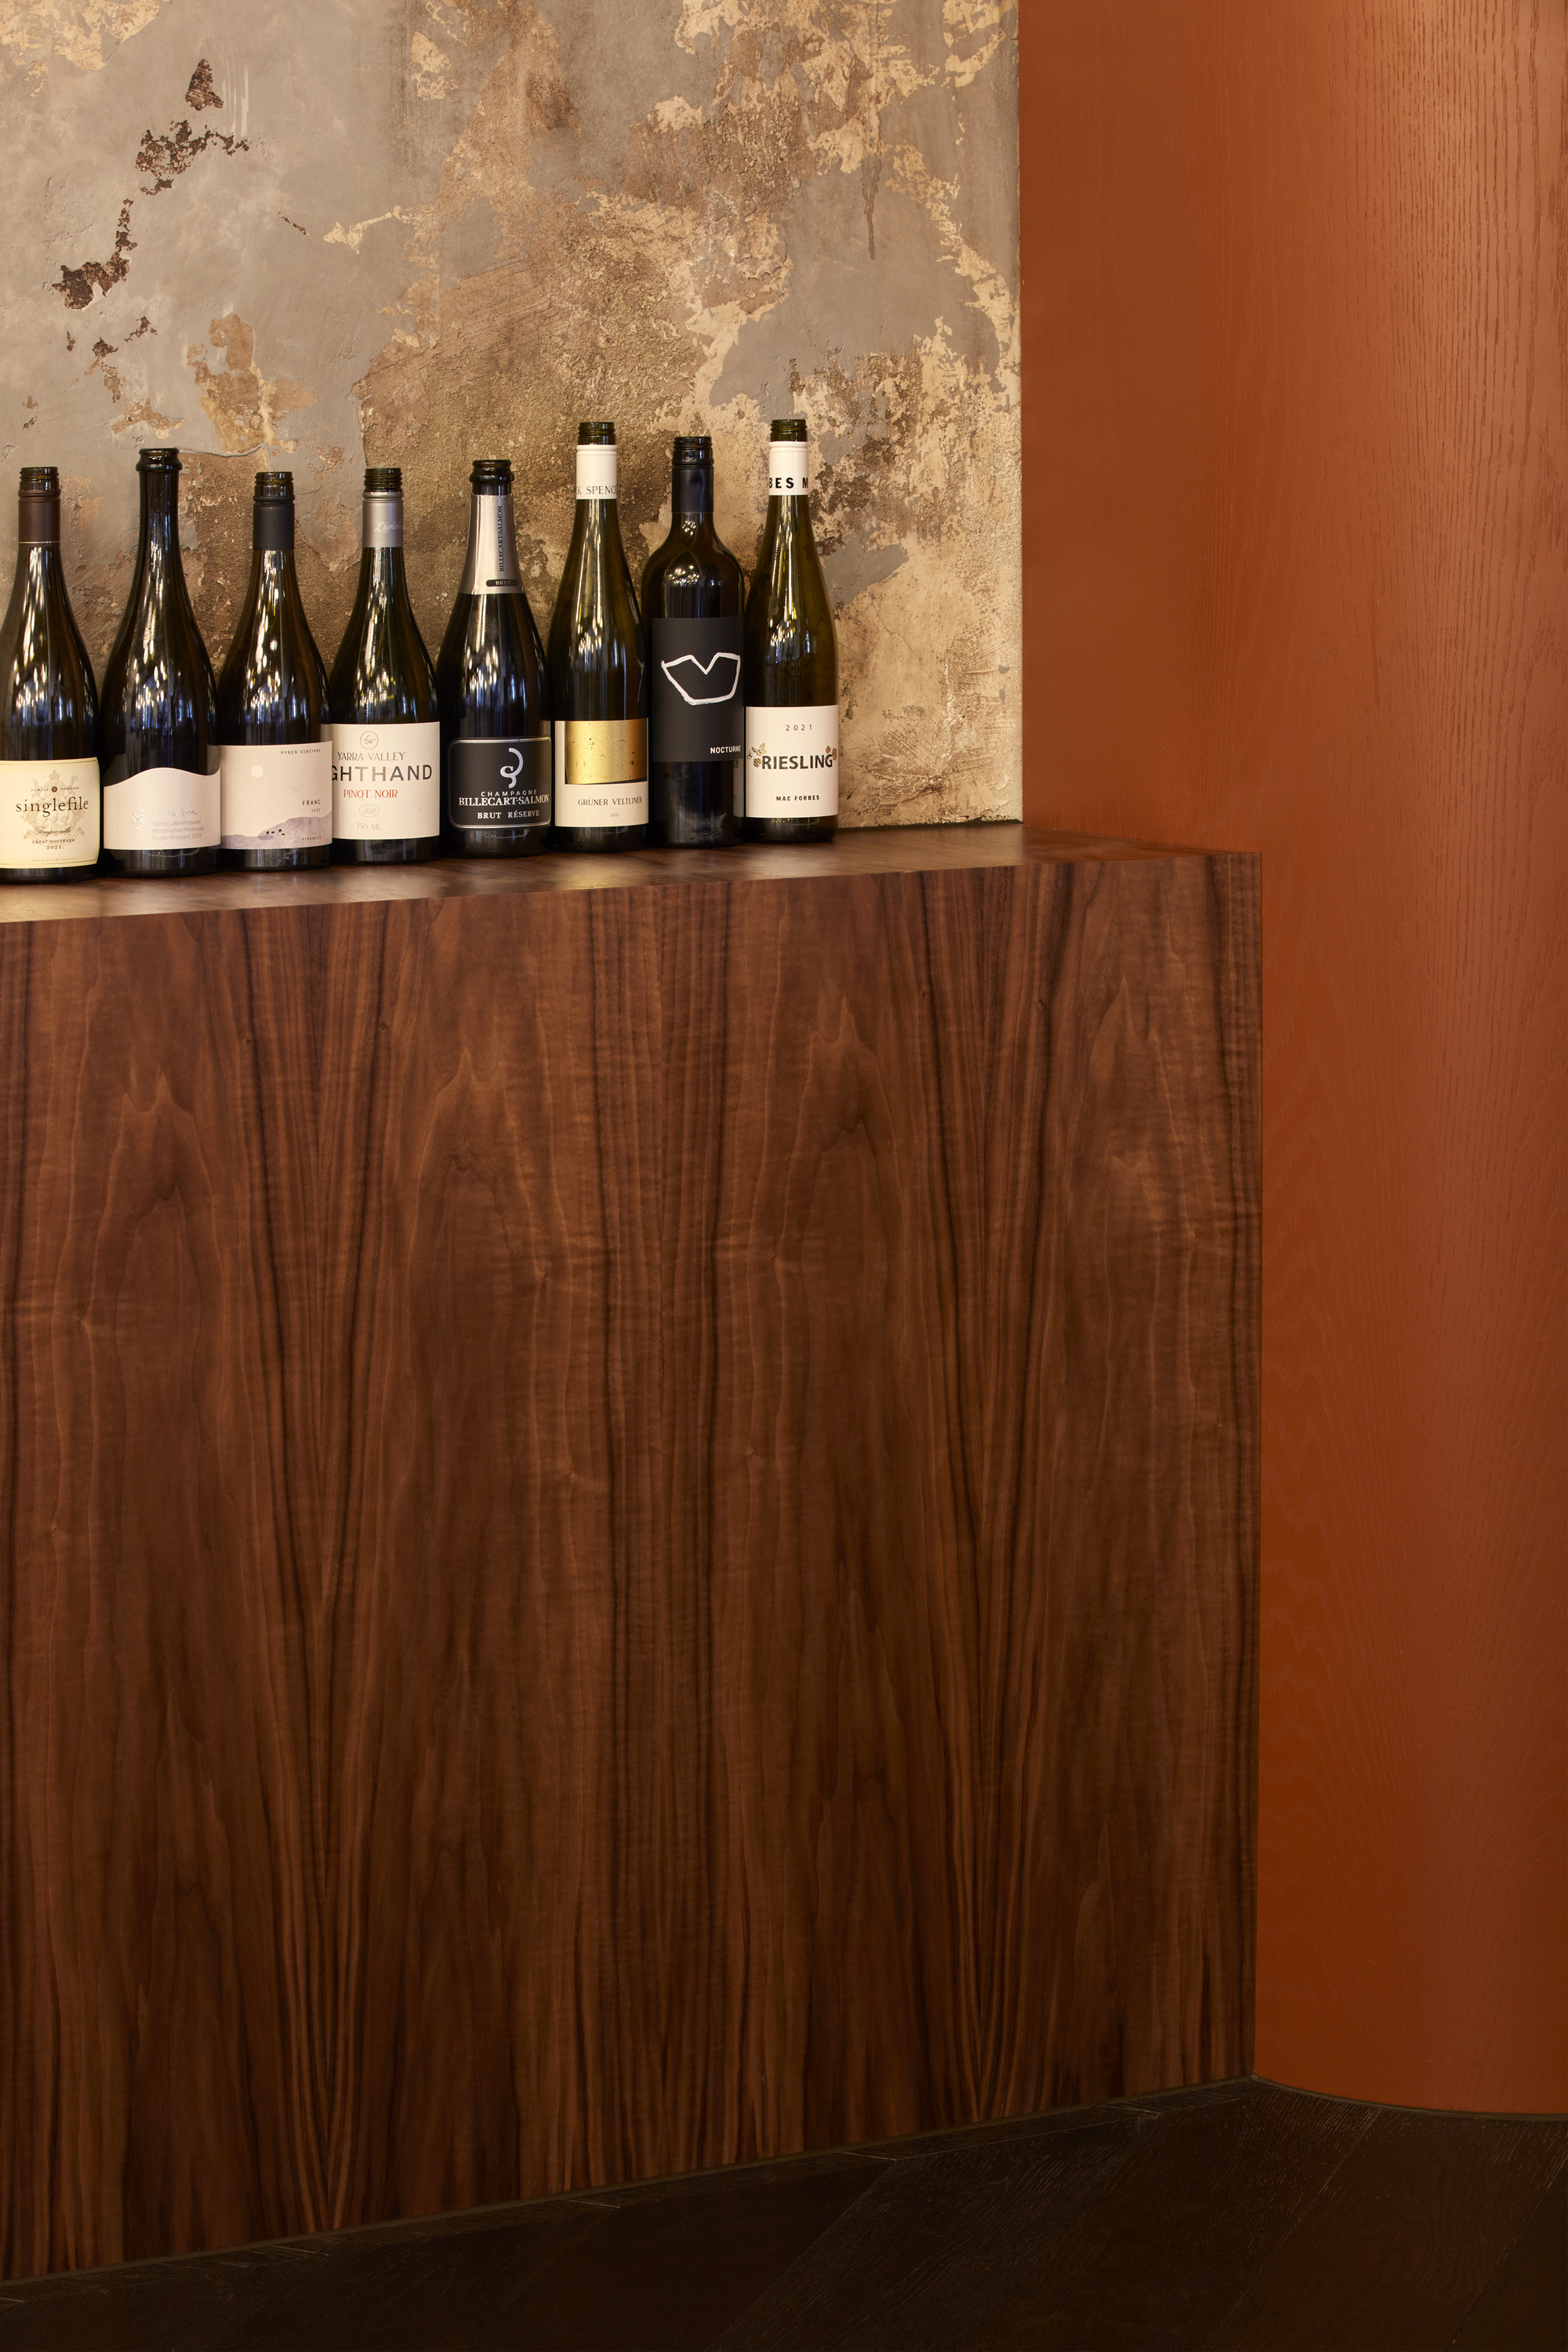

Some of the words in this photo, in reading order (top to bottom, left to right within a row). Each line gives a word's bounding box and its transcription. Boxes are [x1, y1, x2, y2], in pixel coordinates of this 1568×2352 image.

[710, 745, 741, 753] NOCTURNE
[337, 752, 364, 760] YARRA
[368, 752, 405, 760] VALLEY
[761, 754, 833, 769] RIESLING
[332, 764, 433, 782] GHTHAND
[343, 789, 371, 798] PINOT
[375, 789, 397, 798] NOIR
[458, 794, 549, 806] BILLECART-SALMON
[612, 797, 642, 805] VELTLINER
[16, 797, 89, 817] singlefile
[507, 810, 539, 818] RÉSERVE
